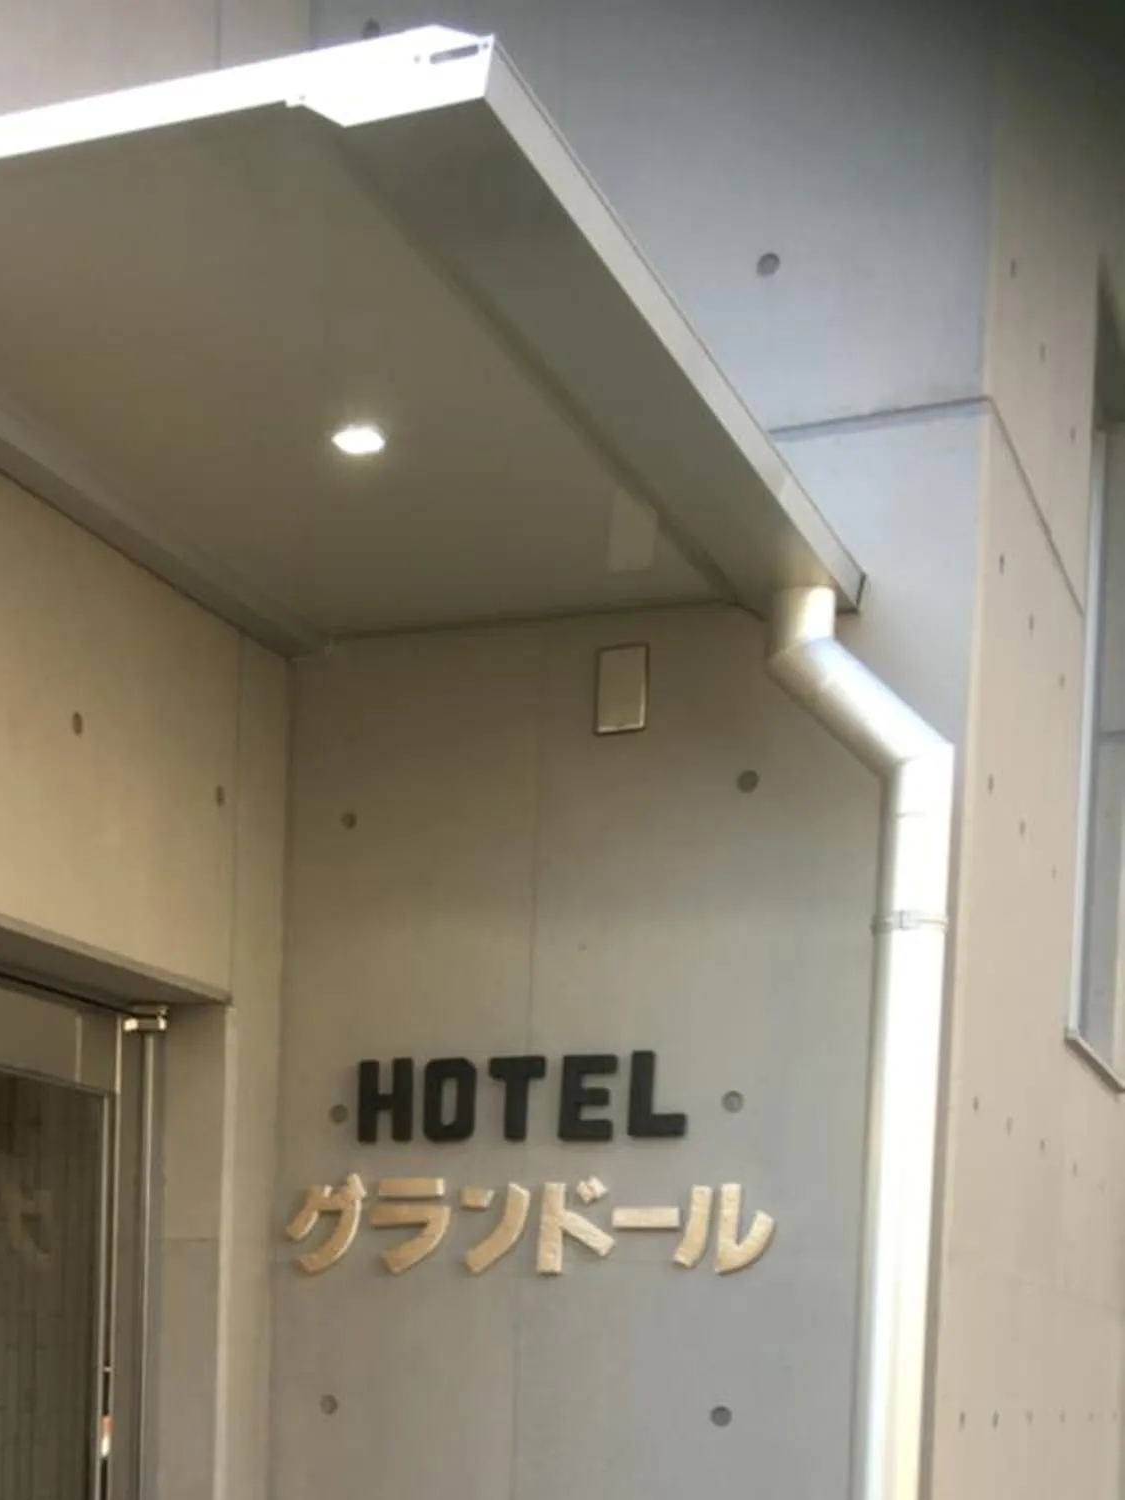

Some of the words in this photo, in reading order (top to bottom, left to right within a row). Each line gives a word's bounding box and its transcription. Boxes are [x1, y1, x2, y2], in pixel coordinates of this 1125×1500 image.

[356, 1050, 688, 1142] HOTEL
[286, 1172, 775, 1276] グランドール
